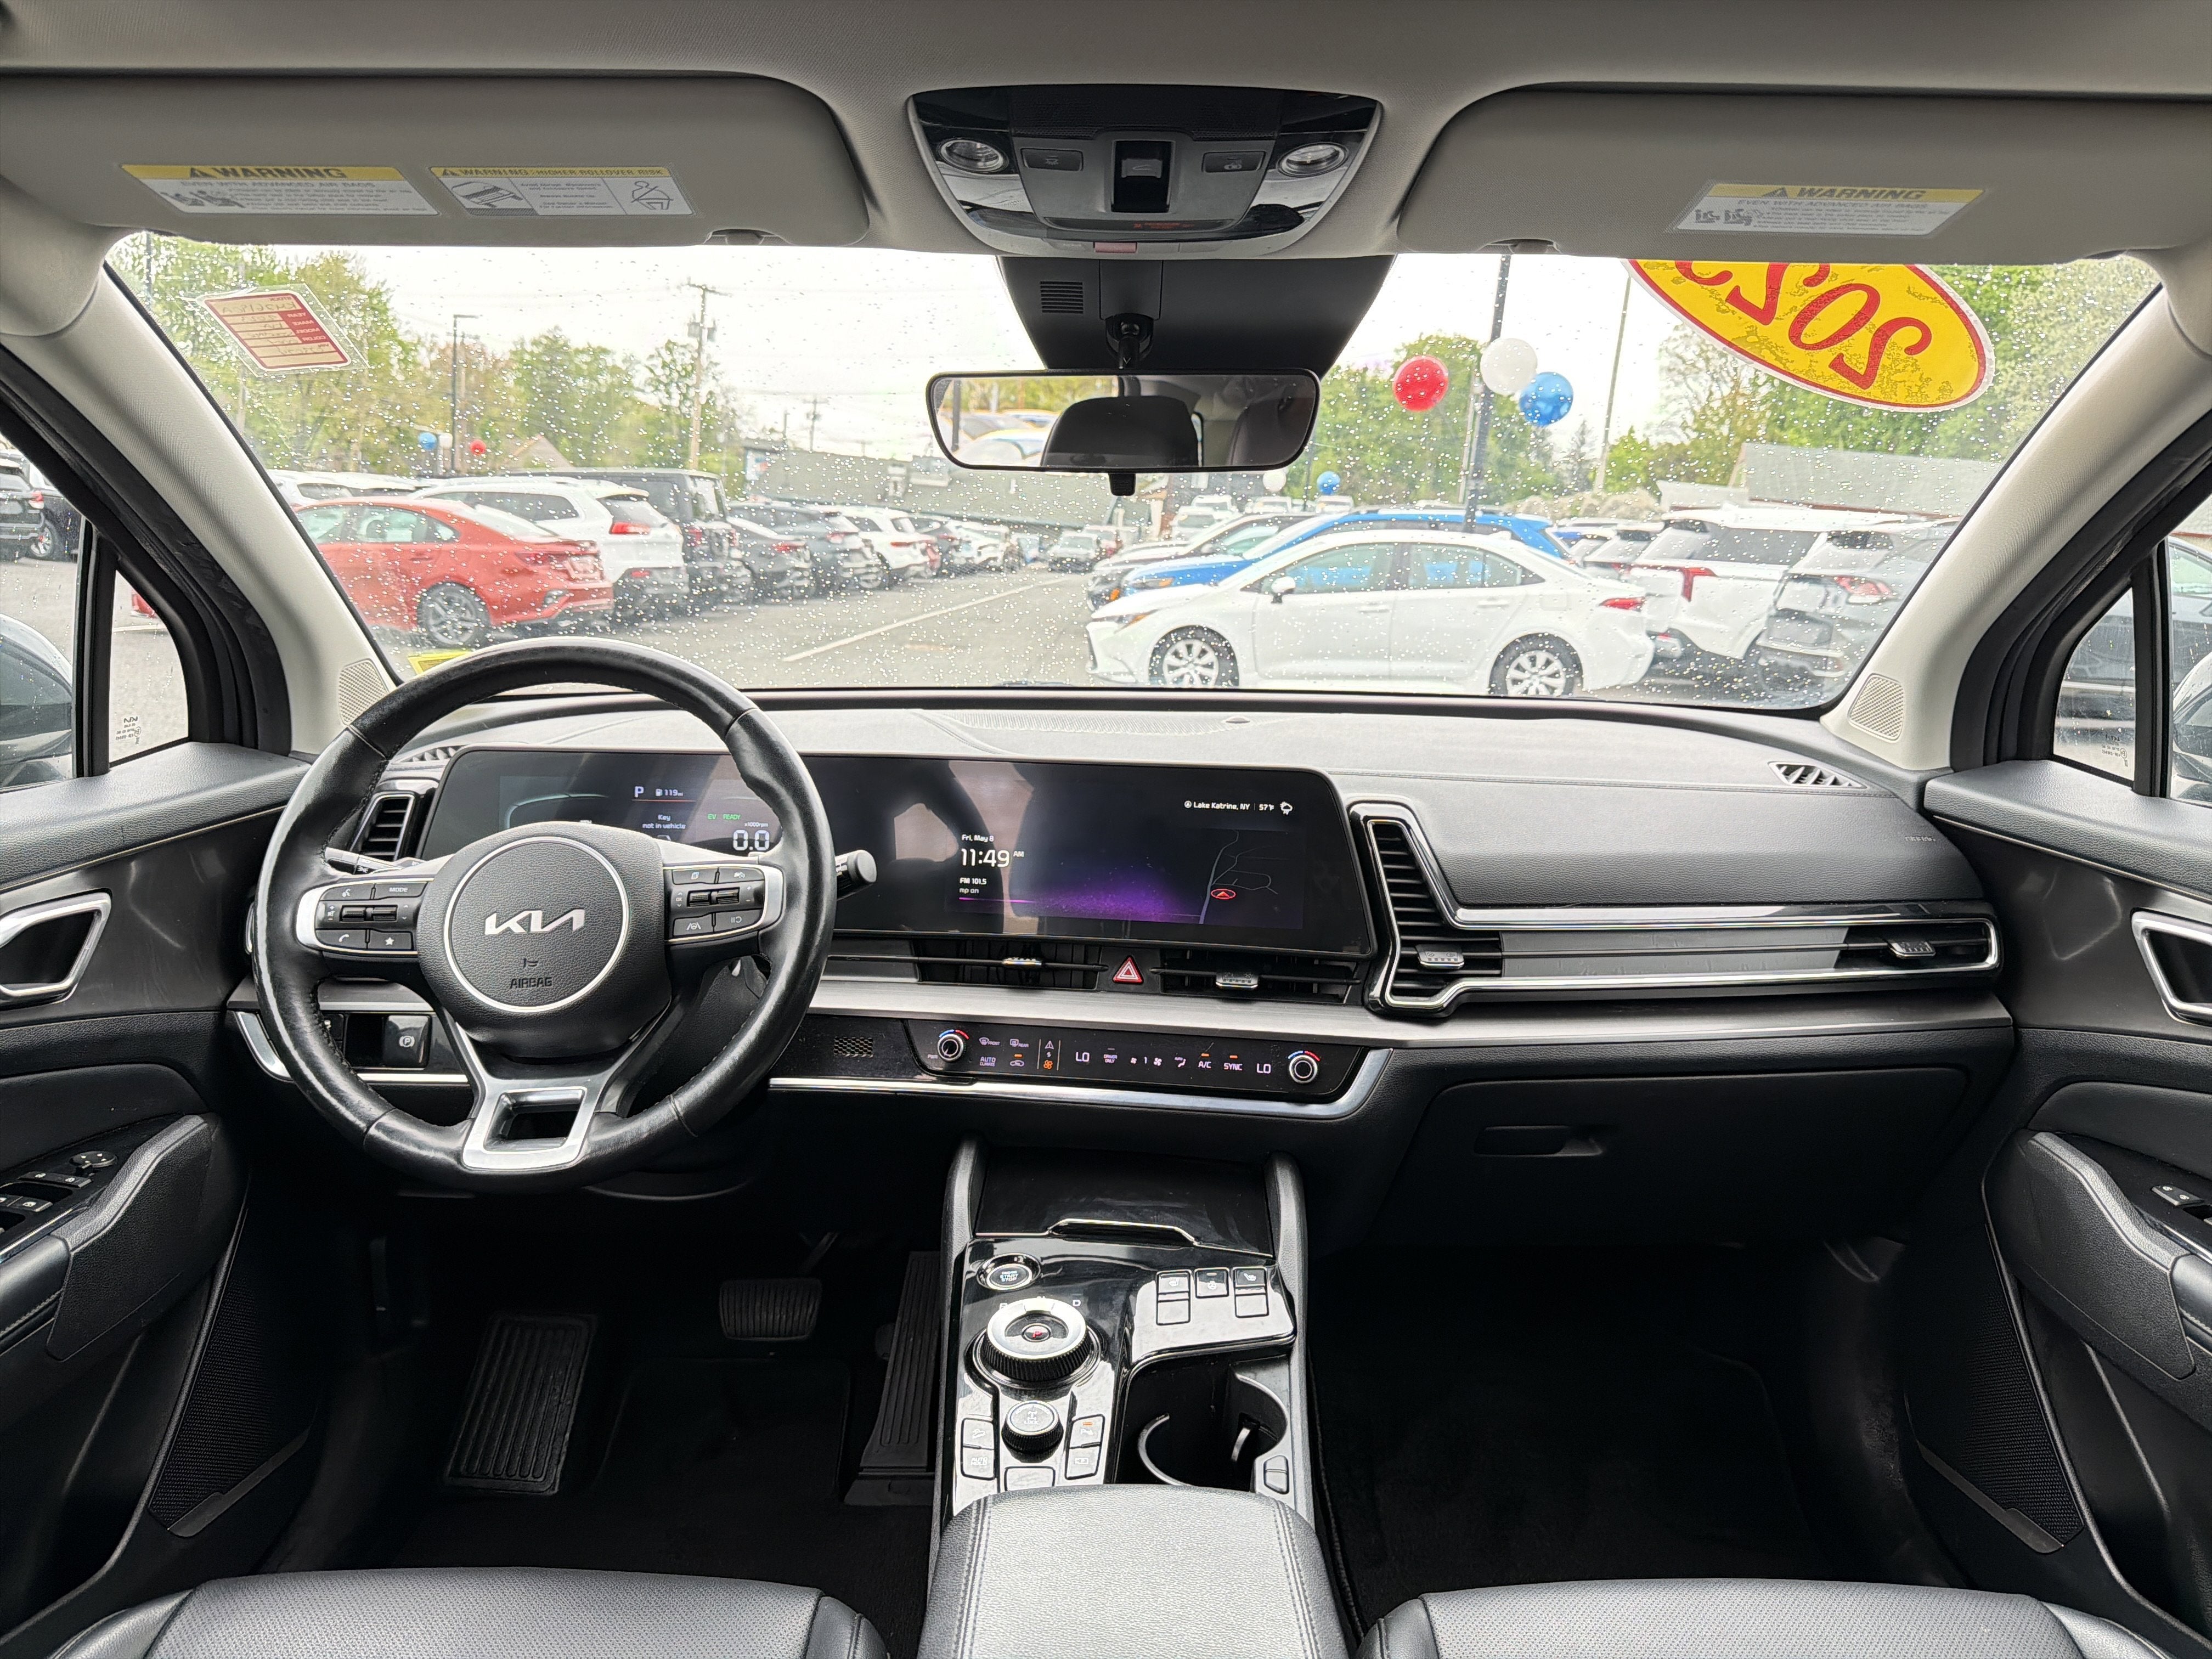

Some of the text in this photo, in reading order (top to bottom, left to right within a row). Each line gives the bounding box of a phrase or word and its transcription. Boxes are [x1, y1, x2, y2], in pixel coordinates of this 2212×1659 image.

[211, 168, 347, 178] WARNING
[1797, 187, 1926, 199] WARNING
[634, 786, 644, 798] P
[733, 830, 770, 851] 0.0
[961, 848, 1009, 867] 11:49
[484, 908, 585, 935] KIA
[509, 977, 553, 989] AIRBAG
[1075, 1052, 1090, 1062] LO
[1198, 1060, 1212, 1069] A/C
[1223, 1063, 1243, 1071] SYNC
[1256, 1063, 1272, 1074] LO
